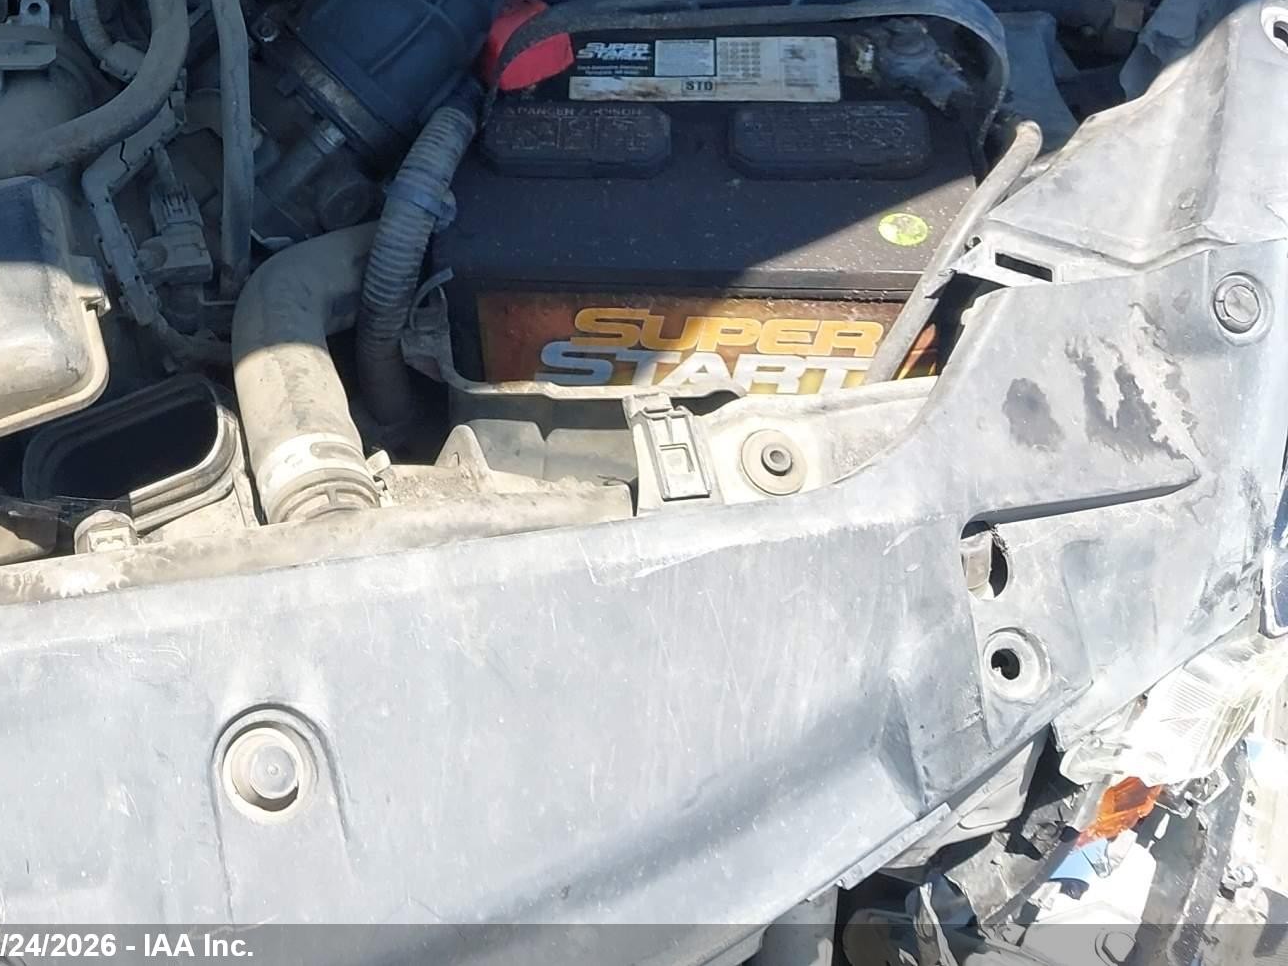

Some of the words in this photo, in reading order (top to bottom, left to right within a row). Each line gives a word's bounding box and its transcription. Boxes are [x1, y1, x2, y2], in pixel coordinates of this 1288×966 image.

[576, 49, 651, 60] START
[585, 42, 650, 51] SUPER
[570, 307, 884, 356] SUPER
[534, 341, 873, 395] START
